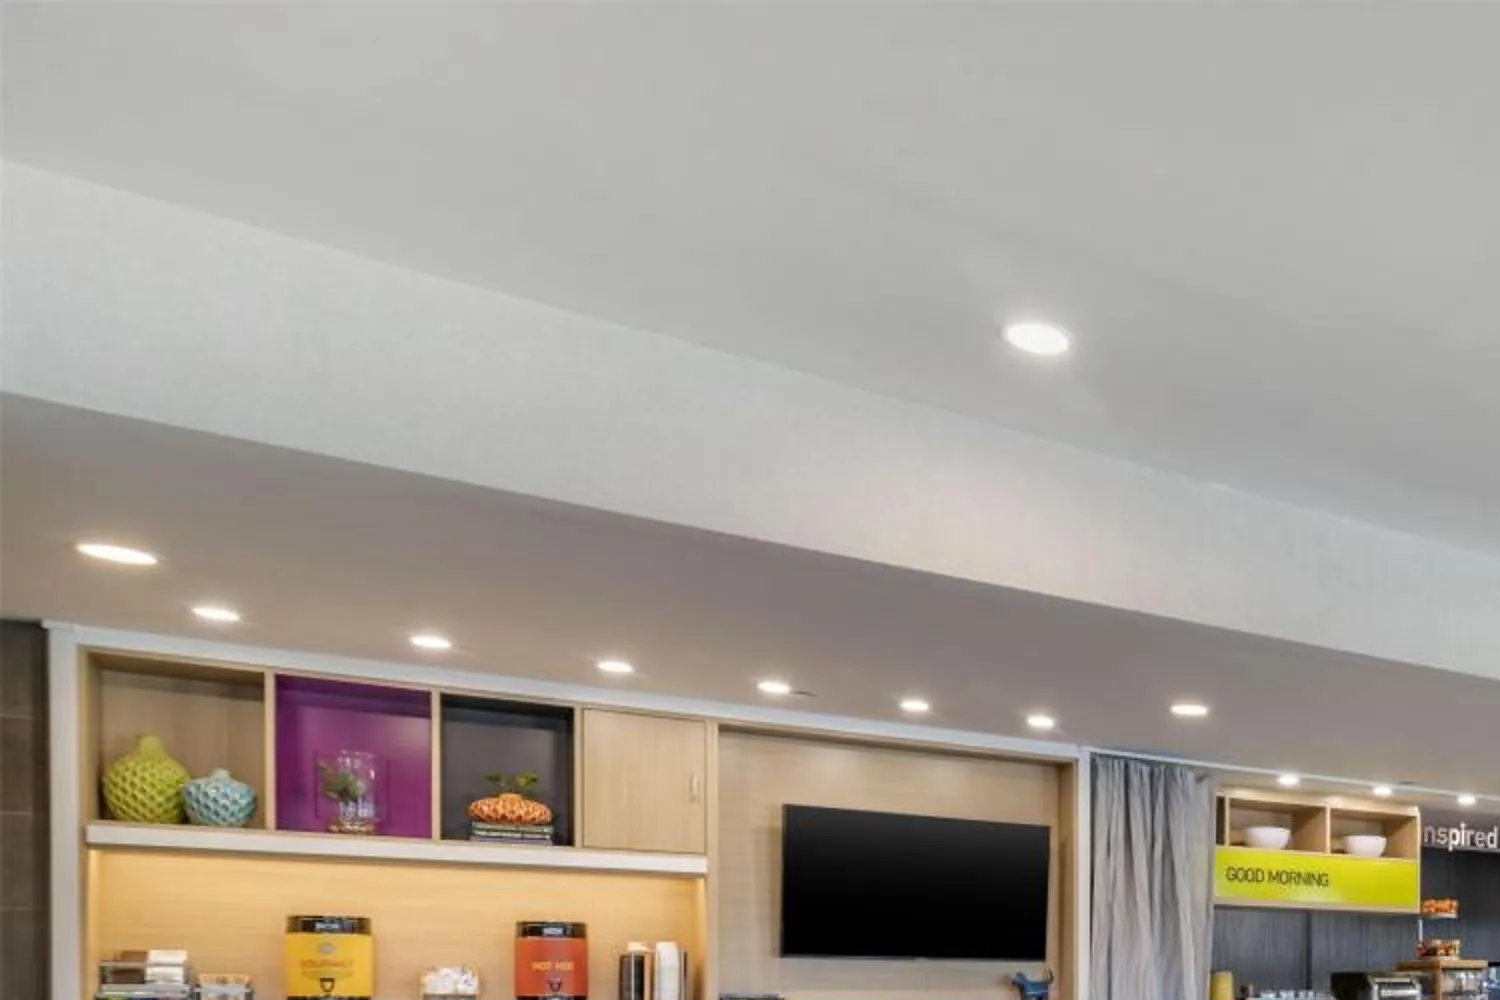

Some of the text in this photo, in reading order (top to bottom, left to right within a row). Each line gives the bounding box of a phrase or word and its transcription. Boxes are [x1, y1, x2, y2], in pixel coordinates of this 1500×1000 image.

[1423, 822, 1498, 852] nspired
[1225, 866, 1329, 887] GOOD MORNING
